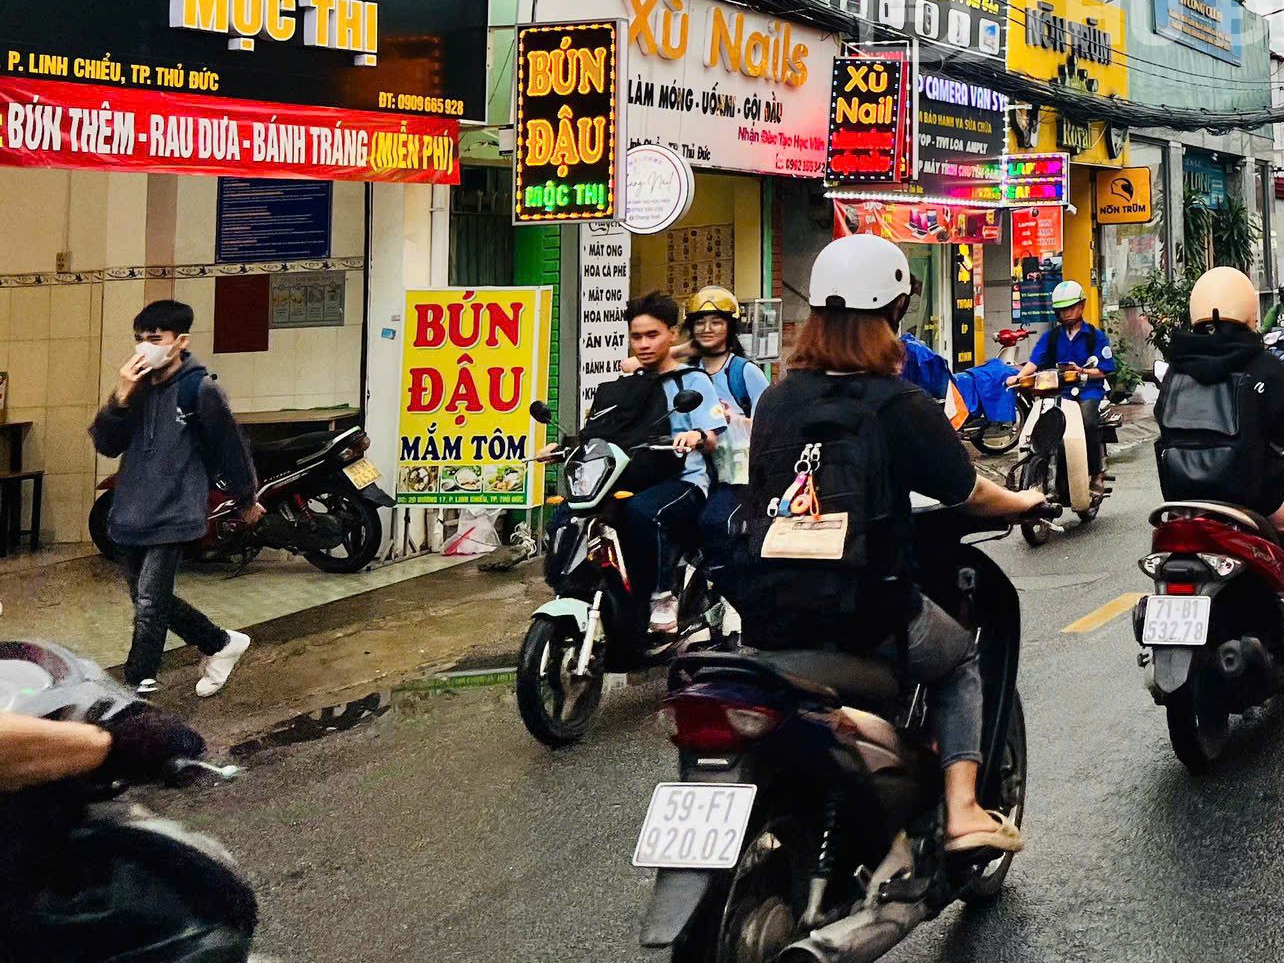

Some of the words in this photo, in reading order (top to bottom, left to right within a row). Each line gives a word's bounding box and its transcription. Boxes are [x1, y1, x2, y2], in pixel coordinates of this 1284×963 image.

[704, 6, 809, 87] Nails
[8, 51, 23, 71] P.
[29, 53, 68, 76] LINH
[74, 52, 125, 84] CHIỂU,
[131, 64, 151, 84] TP.
[156, 64, 183, 87] THỦ
[189, 67, 219, 91] ĐỨC
[527, 37, 605, 96] BÚN
[844, 65, 888, 93] Xù
[628, 74, 654, 106] LÀM
[658, 79, 693, 111] MÓNG
[744, 93, 761, 126] GỘI
[926, 75, 968, 105] CAMERA
[445, 99, 463, 115] 928
[836, 96, 893, 124] Nail
[8, 95, 62, 151] BÚN
[68, 101, 135, 155] THÊM
[150, 114, 193, 158] RAU
[198, 115, 240, 161] DƯA
[253, 115, 306, 164] BÁNH
[310, 121, 368, 167] TRÁNG
[370, 120, 420, 173] (MIỄN
[422, 130, 454, 176] PHÍ)
[526, 105, 606, 177] ĐẬU
[950, 138, 964, 151] LOA
[966, 141, 989, 155] AMPLY
[697, 144, 711, 161] Đức
[574, 182, 605, 210] THỊ
[588, 244, 604, 260] MẬT
[606, 244, 623, 257] ONG
[584, 264, 600, 277] HOA
[601, 262, 611, 277] CÀ
[612, 261, 627, 277] PHÊ
[588, 289, 604, 305] MẬT
[606, 288, 622, 301] ONG
[413, 291, 523, 349] BÚN
[584, 310, 602, 323] HOA
[586, 333, 602, 348] ĂN
[605, 332, 625, 351] VẶT
[586, 360, 605, 374] BÁNH
[606, 363, 612, 373] &
[407, 353, 524, 426] ĐẬU
[400, 422, 463, 461] MẮM
[471, 428, 527, 461] TÔM
[664, 790, 735, 823] 59-F1
